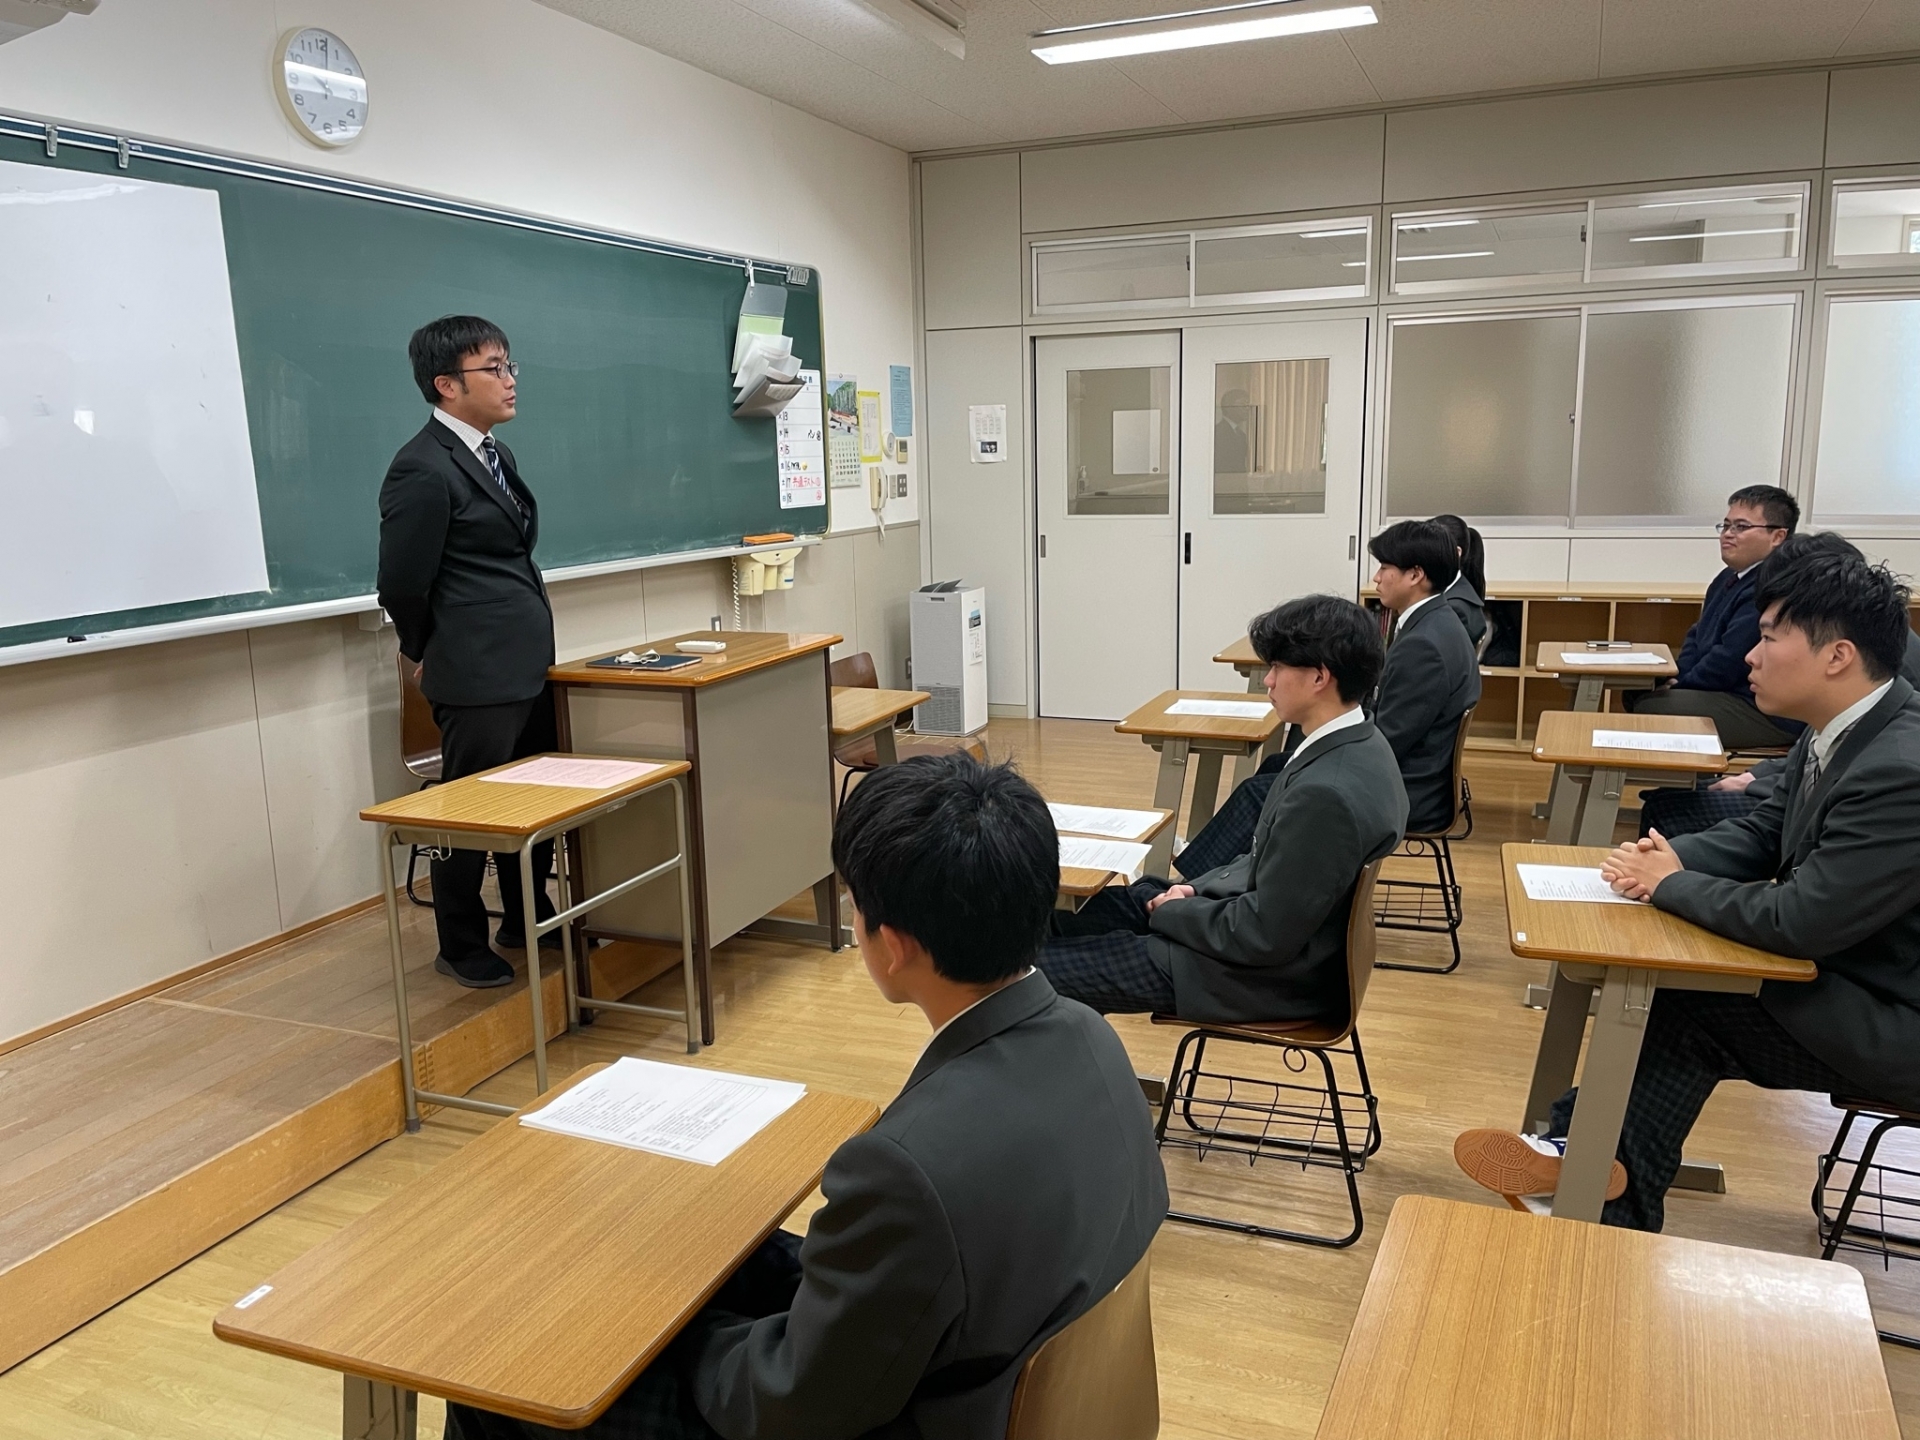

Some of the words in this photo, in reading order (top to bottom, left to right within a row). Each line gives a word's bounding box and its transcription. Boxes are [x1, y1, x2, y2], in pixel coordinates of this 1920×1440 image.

[301, 40, 311, 53] 11
[316, 38, 327, 51] 12
[290, 53, 303, 64] 10
[335, 50, 339, 60] 1
[289, 73, 299, 84] 9
[295, 94, 304, 105] 8
[349, 89, 358, 100] 3
[307, 113, 317, 124] 7
[346, 109, 355, 119] 4
[323, 123, 332, 134] 6
[338, 120, 347, 131] 5
[783, 411, 789, 421] 13
[786, 477, 791, 488] 17
